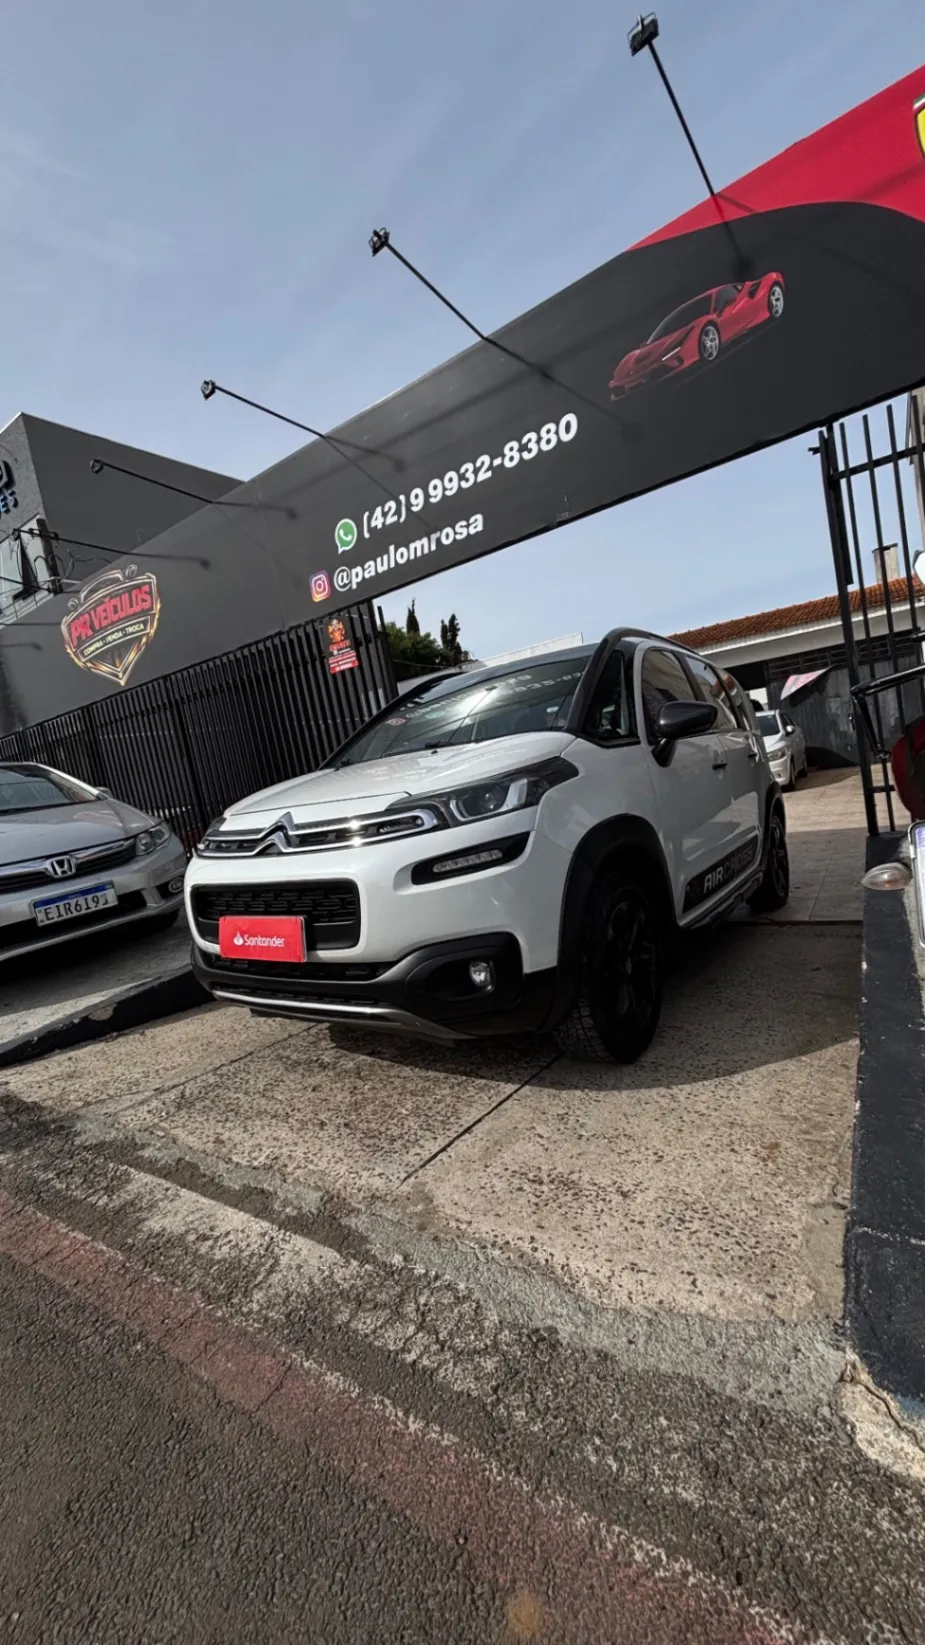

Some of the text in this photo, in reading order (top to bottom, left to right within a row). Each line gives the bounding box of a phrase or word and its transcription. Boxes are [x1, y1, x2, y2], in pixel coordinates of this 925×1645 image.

[363, 494, 406, 539] (42)
[428, 412, 578, 504] 9932-8380
[333, 513, 484, 592] @paulomrosa
[70, 612, 94, 649] PR
[125, 622, 145, 634] TROCA
[244, 933, 286, 948] Santander
